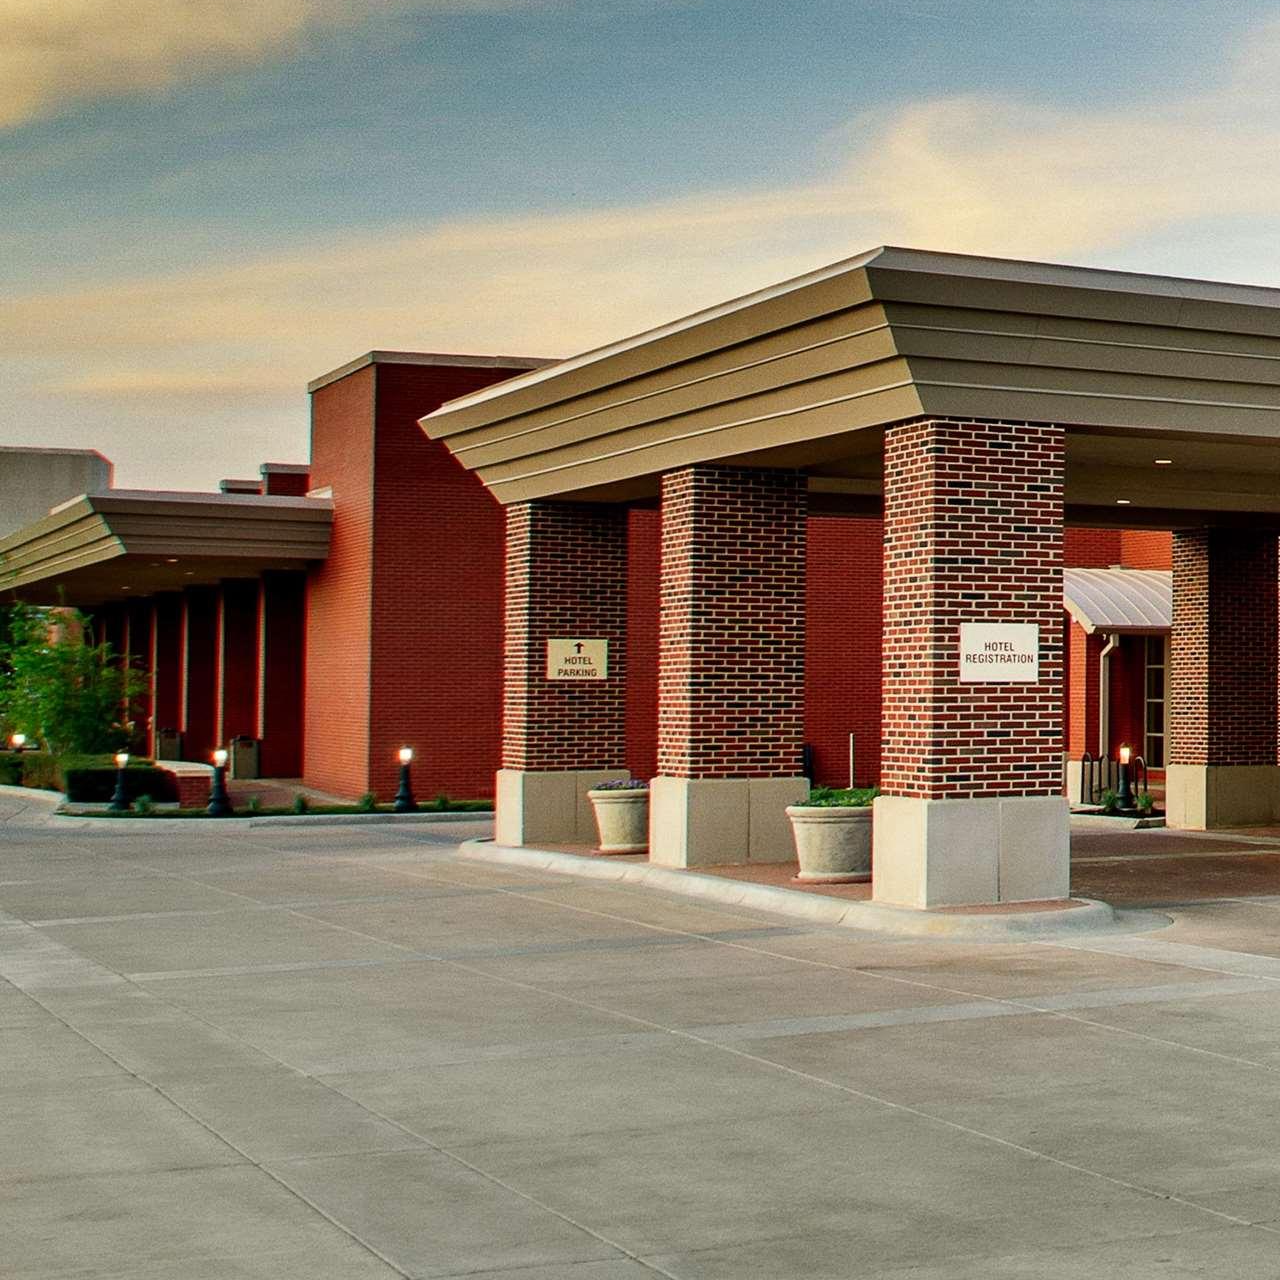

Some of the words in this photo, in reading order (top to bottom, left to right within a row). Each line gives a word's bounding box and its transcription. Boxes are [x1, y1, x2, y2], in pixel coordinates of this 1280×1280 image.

[985, 642, 1014, 652] HOTEL
[564, 656, 593, 665] HOTEL
[965, 653, 1034, 663] REGISTRATION
[557, 668, 598, 677] PARKING
